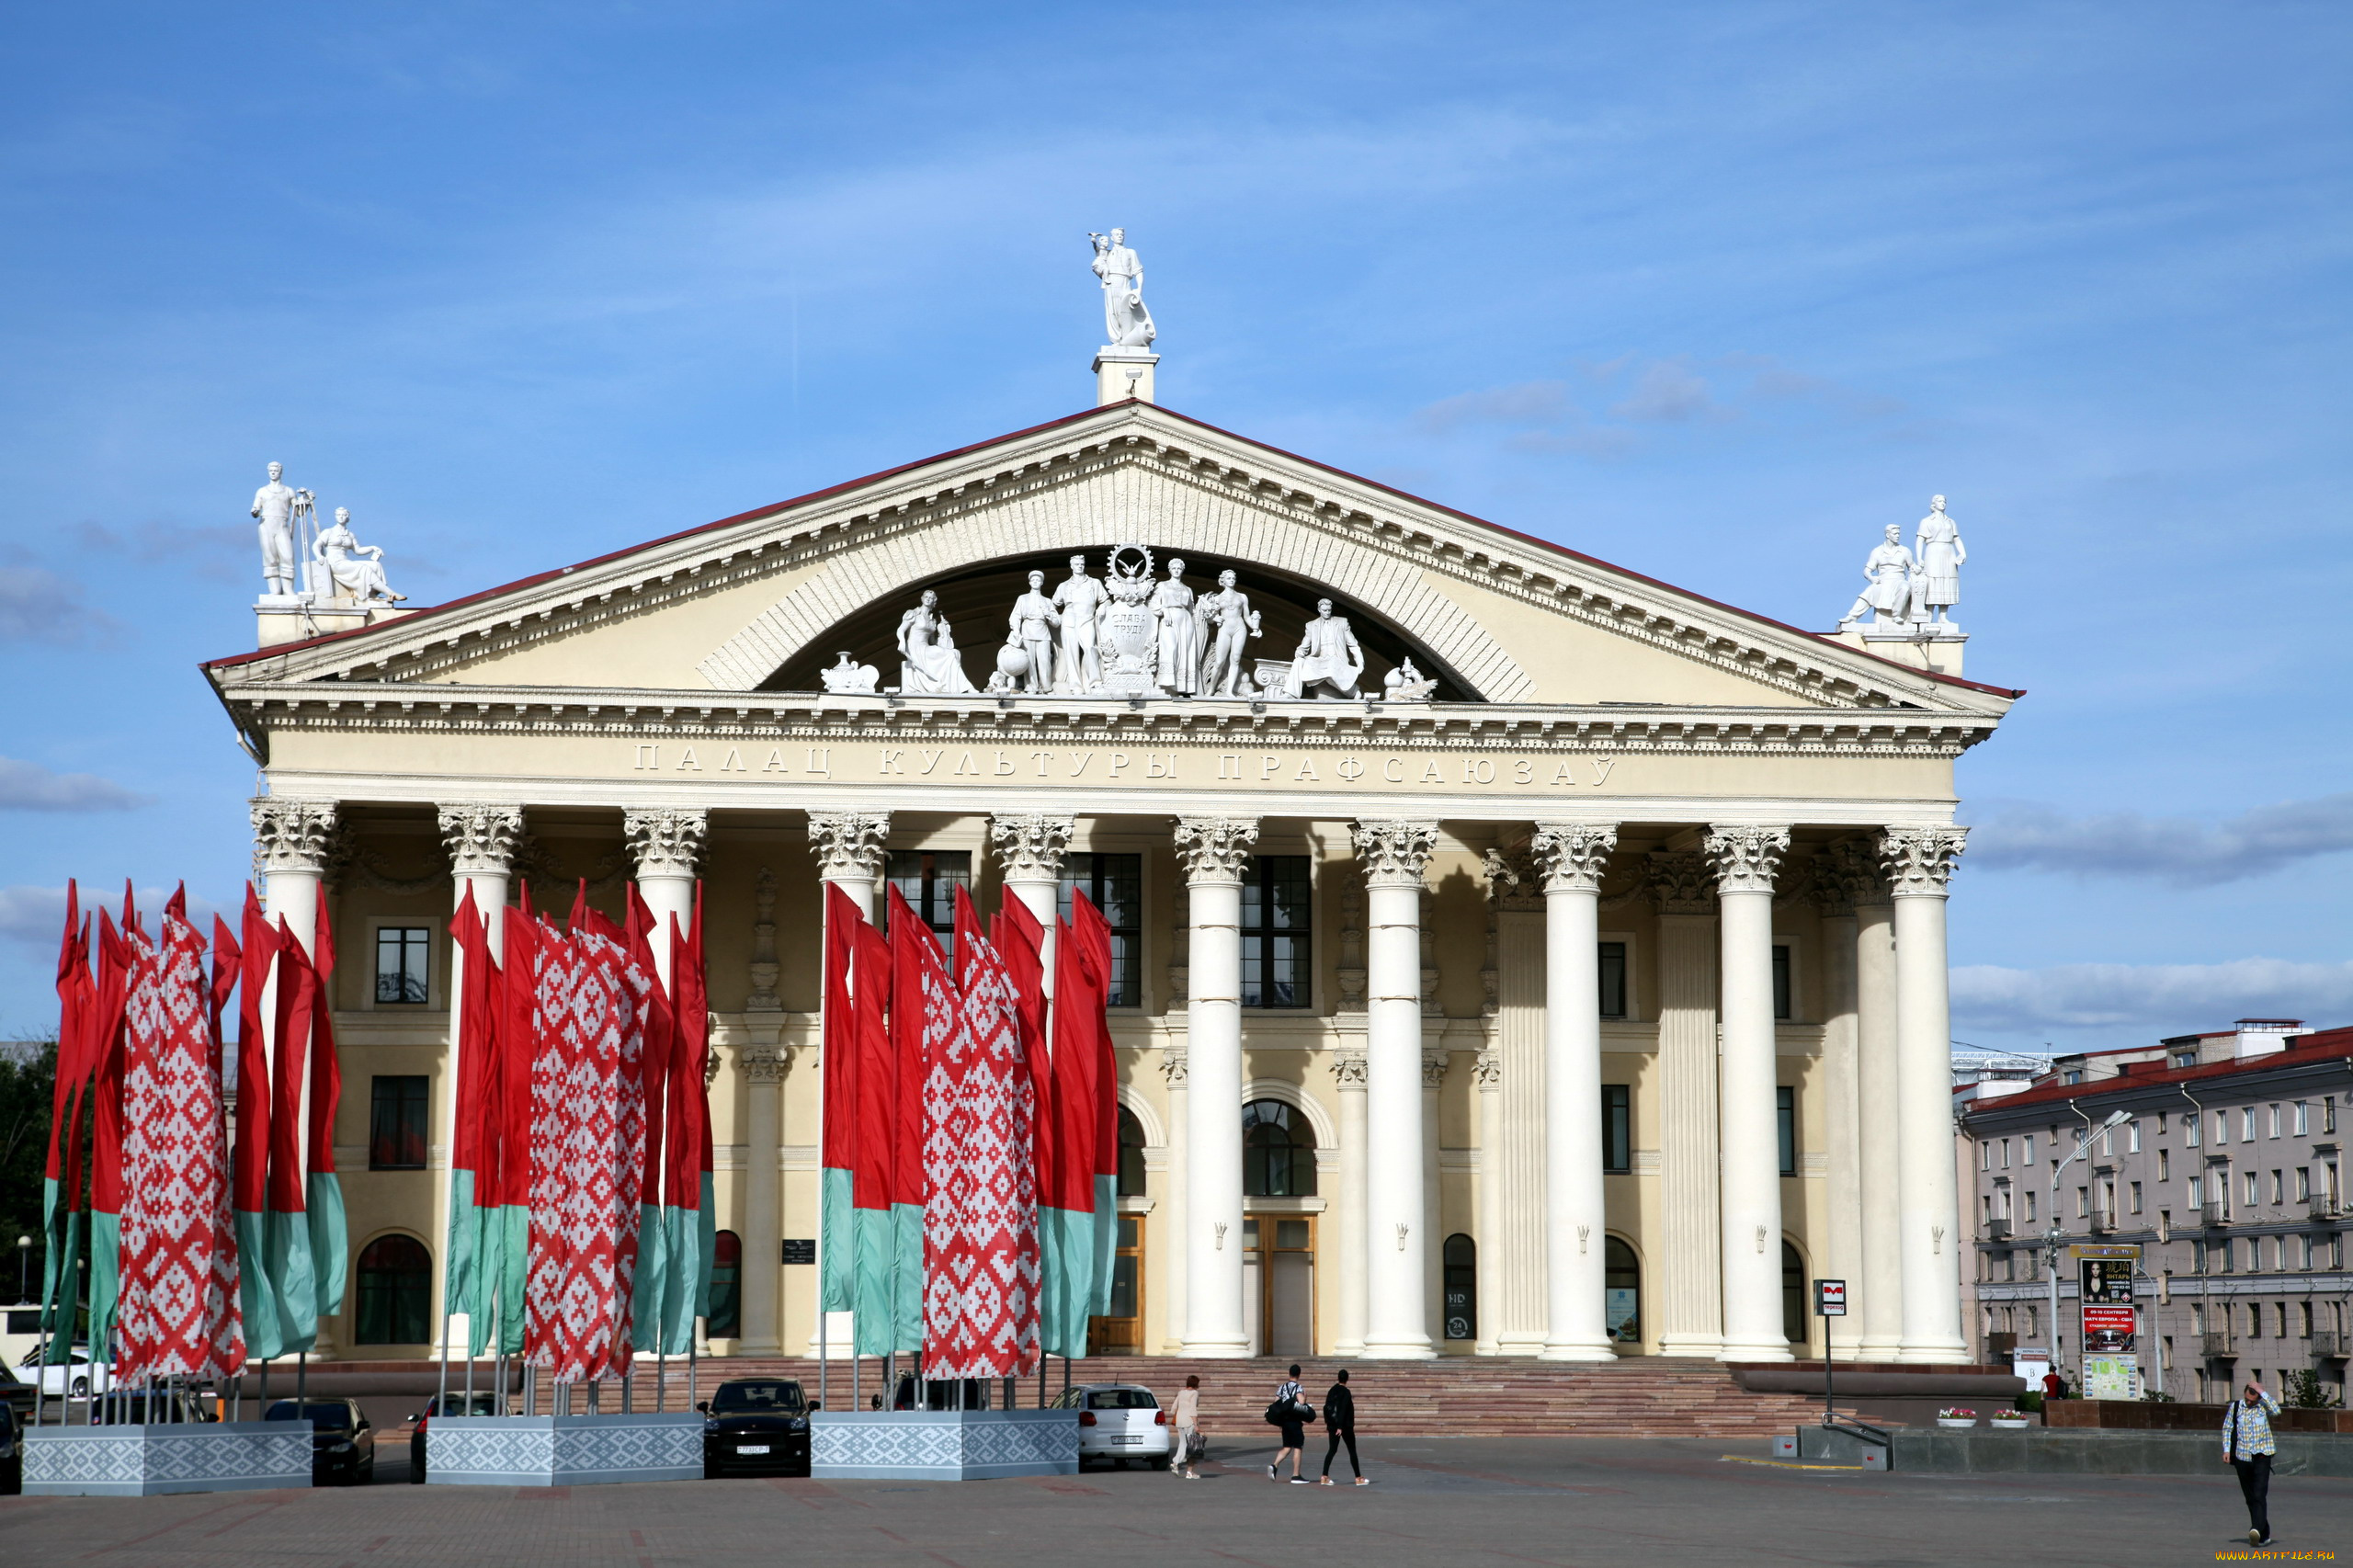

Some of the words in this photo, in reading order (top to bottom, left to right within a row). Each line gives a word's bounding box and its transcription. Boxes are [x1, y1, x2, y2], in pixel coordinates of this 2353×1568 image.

[1112, 614, 1146, 622] СЛАВА
[1114, 625, 1145, 633] ТРУДУ
[634, 744, 832, 778] ПАЛАЦ
[880, 749, 1178, 778] КУЛЬТУРЫ
[1217, 754, 1616, 787] ПРАФСАЮЗАЎ
